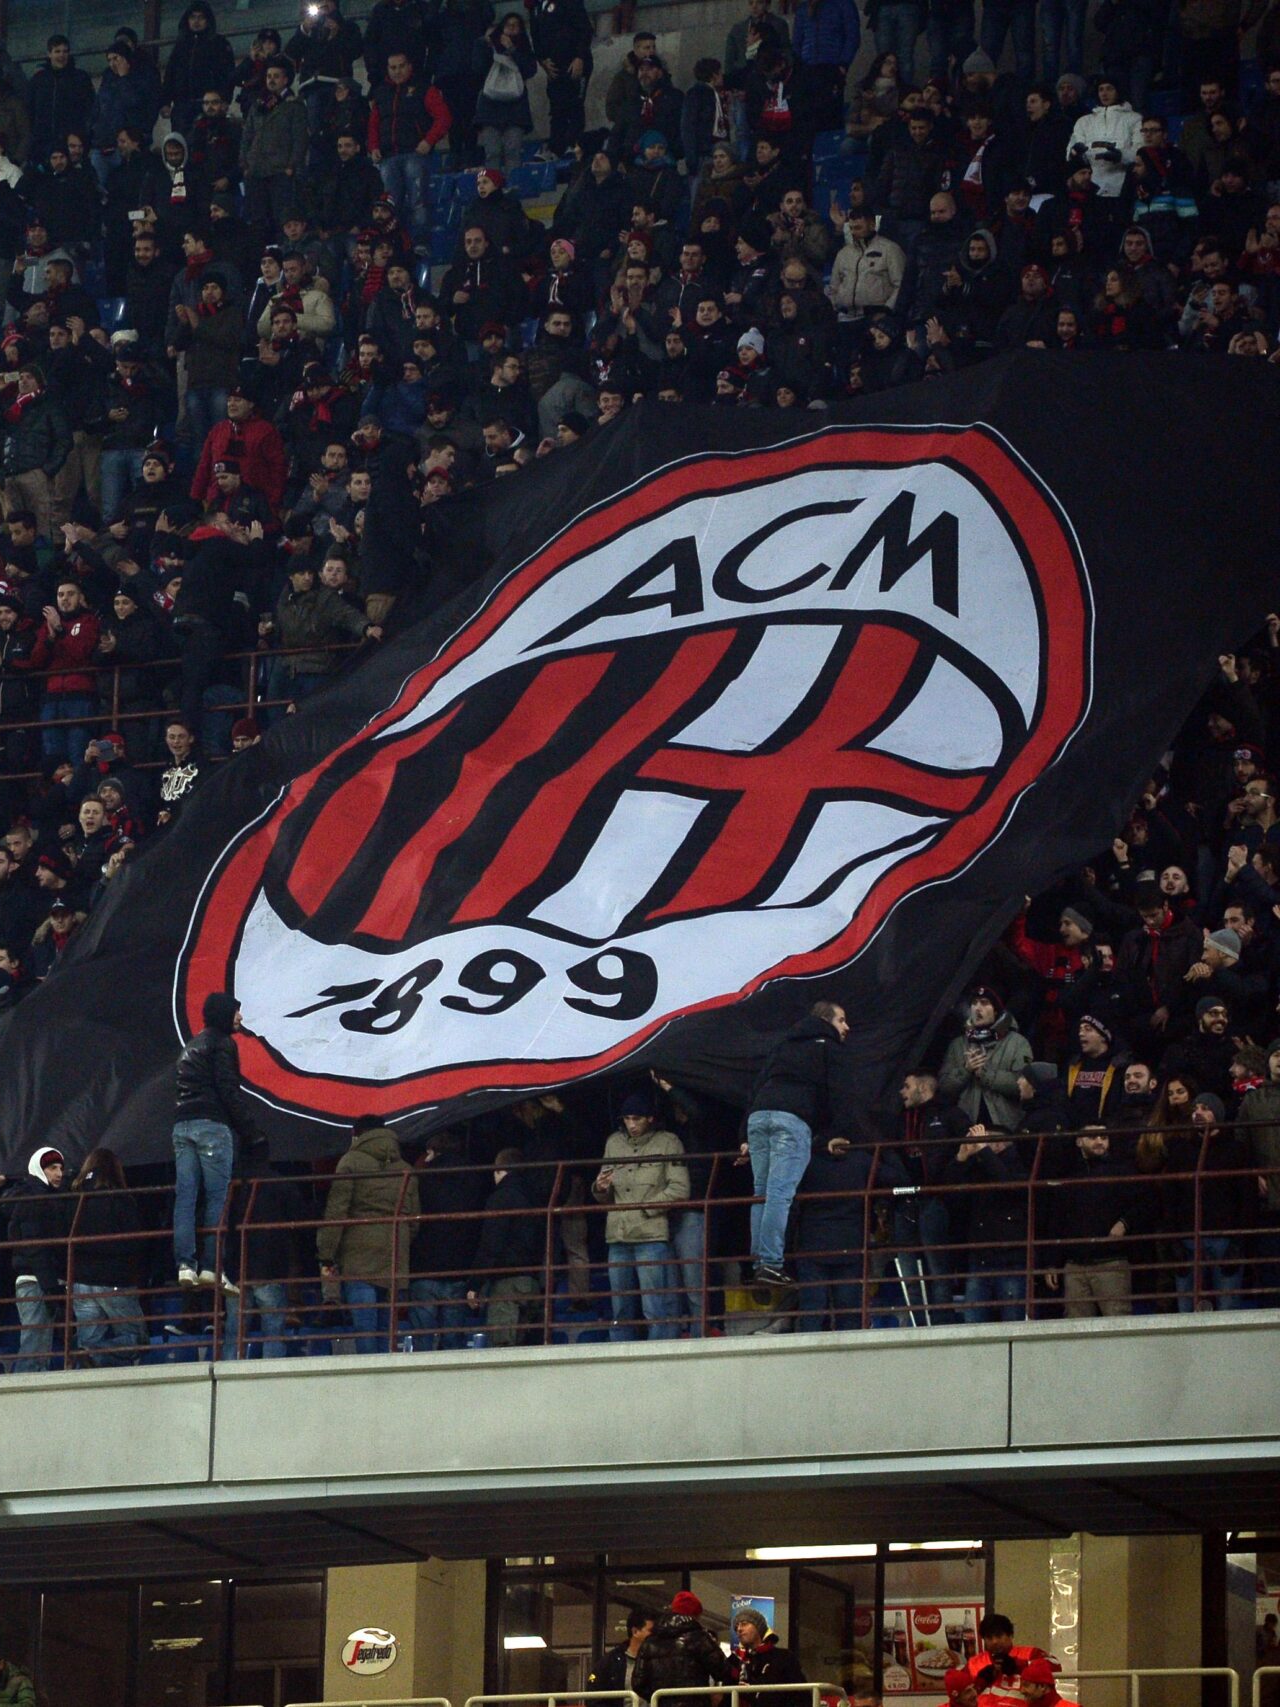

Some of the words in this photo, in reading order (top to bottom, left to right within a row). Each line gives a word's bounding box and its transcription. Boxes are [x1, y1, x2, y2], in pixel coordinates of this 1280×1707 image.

[518, 490, 959, 655] ACM
[282, 946, 659, 1035] 1899
[347, 1640, 392, 1666] Segafredo
